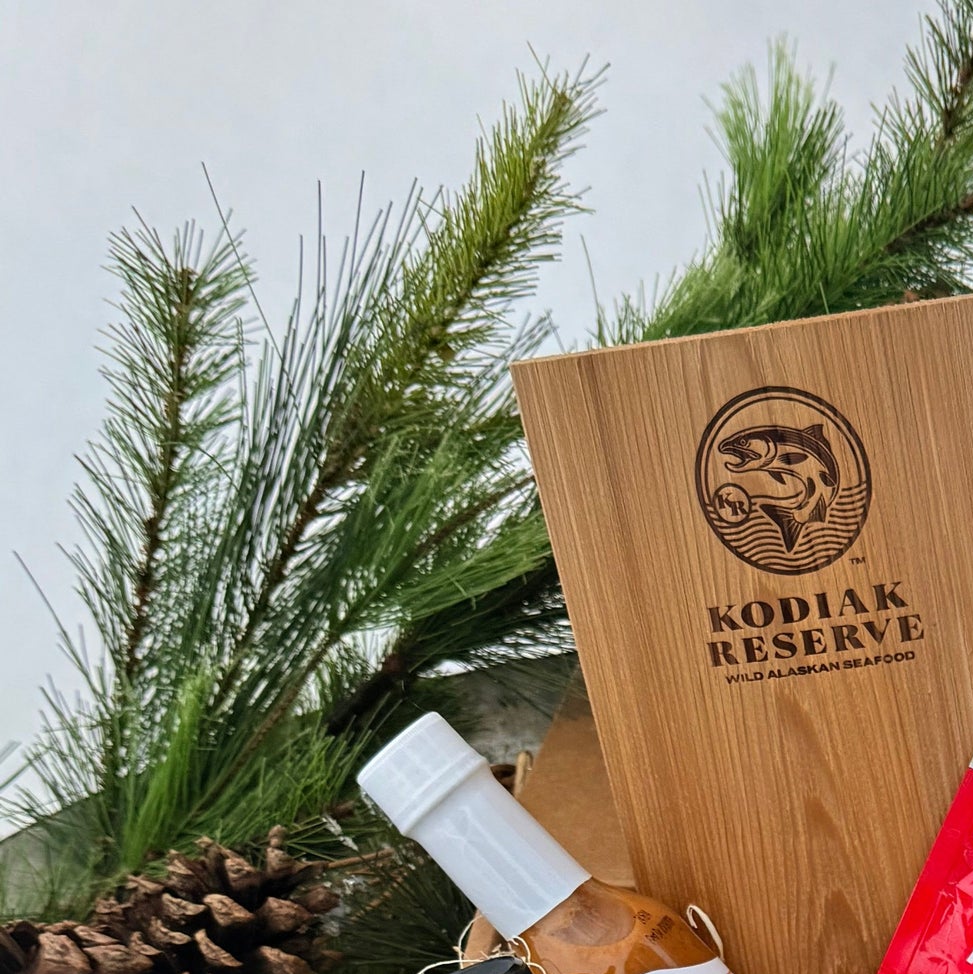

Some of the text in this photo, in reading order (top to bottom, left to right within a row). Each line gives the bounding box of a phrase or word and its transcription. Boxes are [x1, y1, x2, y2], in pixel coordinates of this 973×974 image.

[707, 582, 909, 633] KODIAK
[707, 613, 925, 667] RESERVE
[725, 650, 916, 684] WILD ALASKAN SEAFOOD
